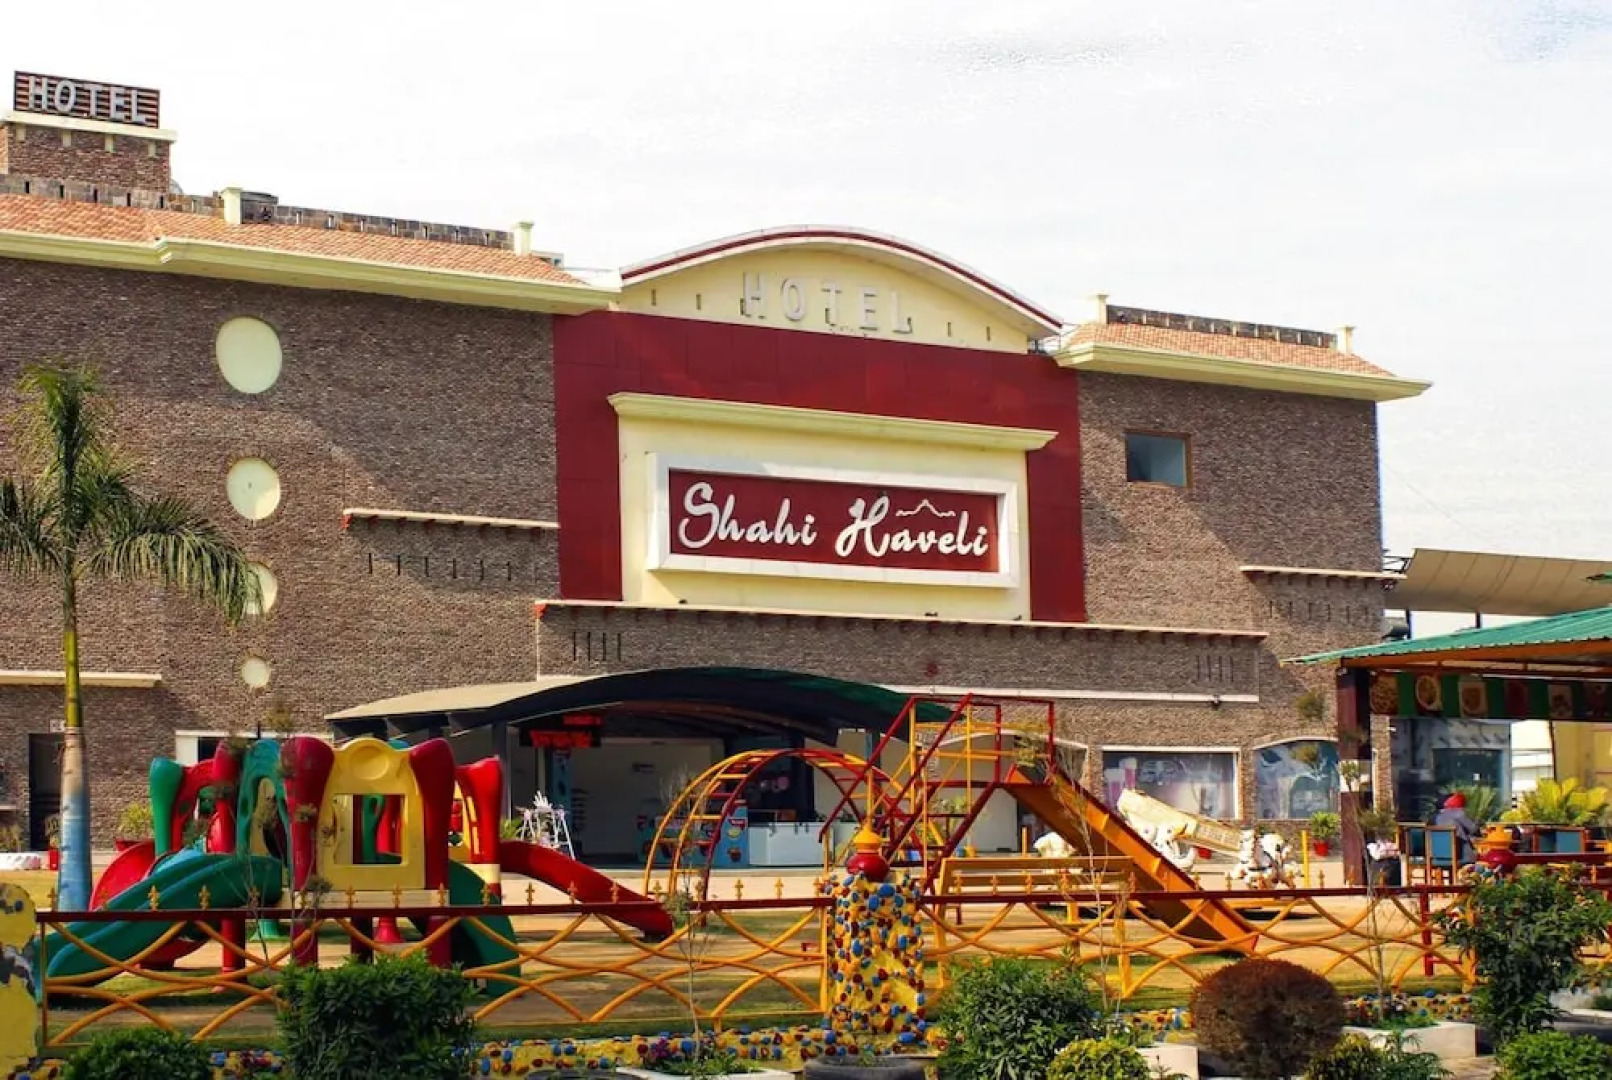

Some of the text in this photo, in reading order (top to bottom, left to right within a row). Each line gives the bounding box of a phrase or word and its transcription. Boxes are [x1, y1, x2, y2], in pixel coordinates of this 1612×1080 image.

[28, 75, 147, 124] HOTEL
[741, 271, 912, 333] HOTEL
[678, 481, 989, 557] Shahi Haveli
